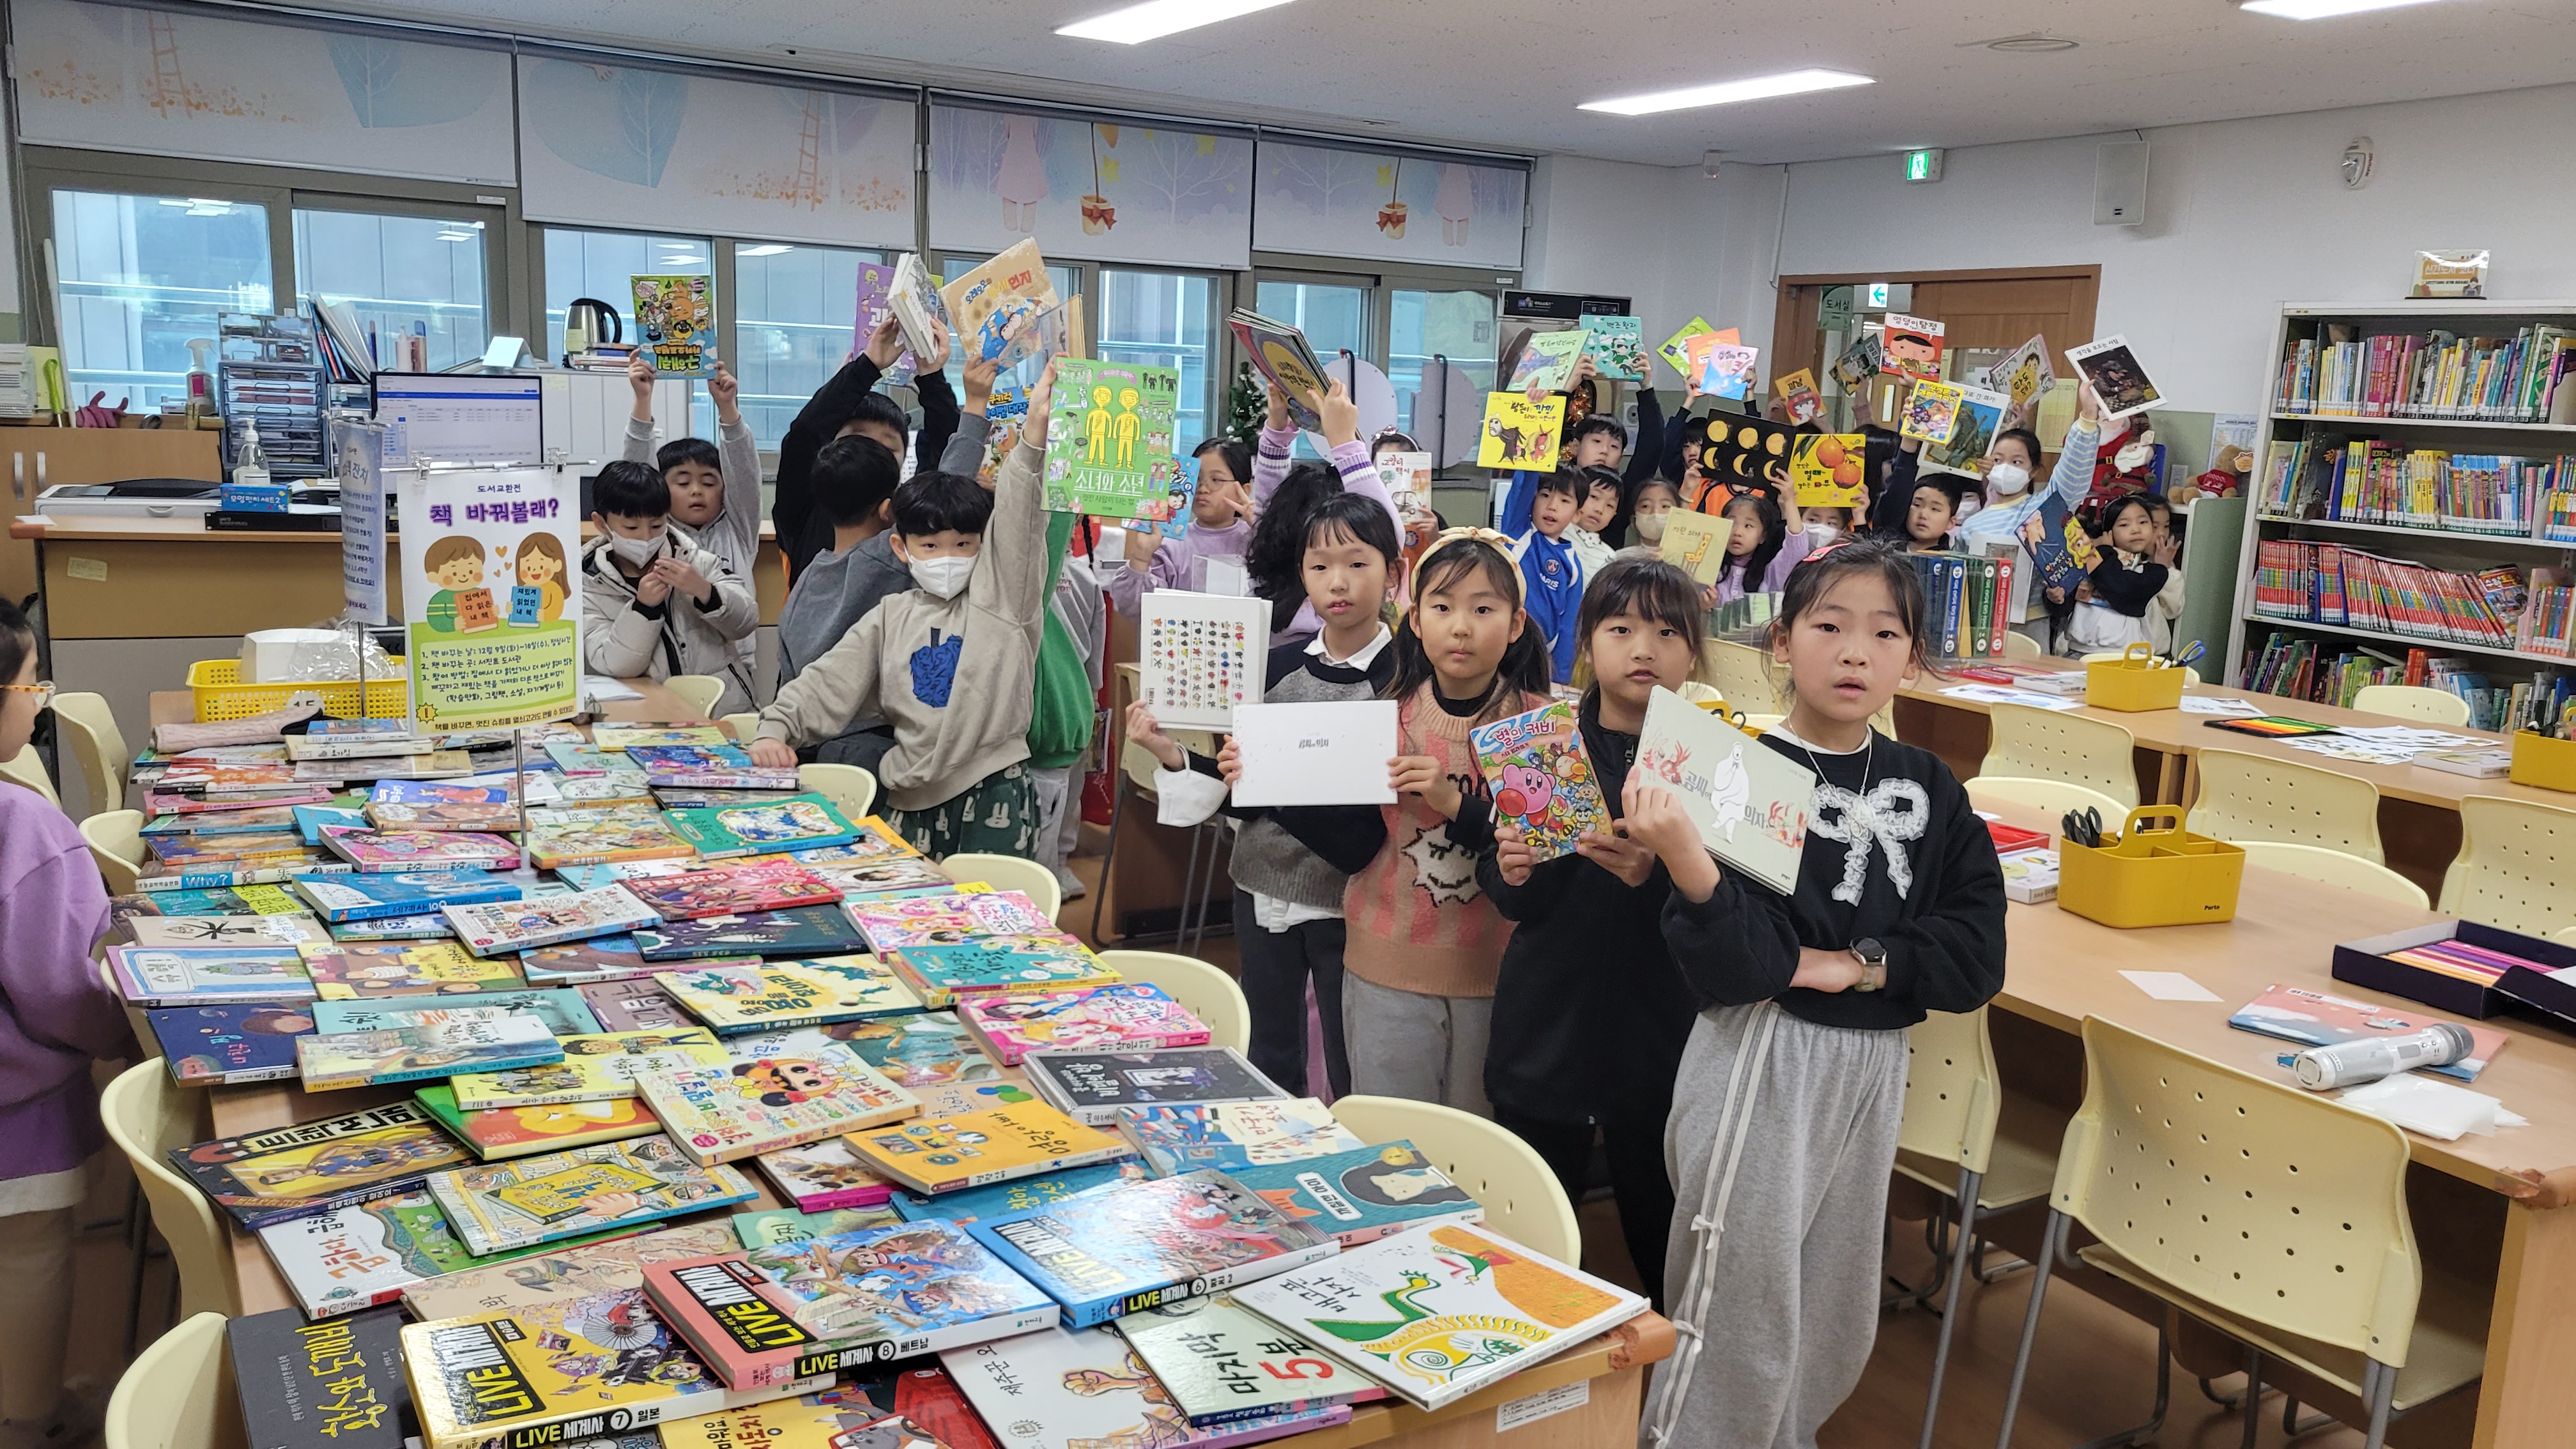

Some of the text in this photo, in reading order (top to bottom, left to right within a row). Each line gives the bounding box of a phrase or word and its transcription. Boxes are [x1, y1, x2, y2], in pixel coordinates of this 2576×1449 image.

[1826, 300, 1849, 310] 도서실
[1382, 454, 1403, 466] 고양이
[477, 484, 521, 493] 도서교환전
[1074, 470, 1114, 493] 소녀와
[1119, 473, 1144, 494] 소년
[430, 497, 559, 526] 책 바꿔볼래?
[464, 591, 487, 601] 집에서
[478, 601, 492, 610] 읽은
[431, 650, 440, 658] 책
[441, 648, 463, 657] 바꾸는
[466, 647, 476, 656] 날:
[479, 646, 493, 655] 12월
[441, 660, 464, 668] 바꾸는
[502, 655, 522, 664] 도서관
[433, 672, 448, 681] 참여
[471, 669, 493, 678] 집에서
[505, 666, 531, 675] 읽었거나
[540, 661, 551, 670] 이상
[462, 681, 482, 690] 재밌는
[533, 673, 549, 682] 책으로
[485, 689, 509, 700] 그림책,
[510, 688, 525, 697] 소설,
[556, 681, 564, 689] 등)
[435, 723, 448, 731] 책을
[451, 721, 474, 730] 바꾸면,
[513, 712, 542, 723] 열쇠고리도
[1495, 720, 1556, 747] 별의 커비
[1683, 774, 1767, 831] 곰씨의 의자
[185, 874, 228, 887] Why?
[1130, 1293, 1160, 1312] LIVE
[1160, 1285, 1188, 1303] 세계사
[800, 1353, 838, 1376] LIVE
[839, 1345, 874, 1368] 세계사
[900, 1337, 930, 1354] 베트남
[1177, 1332, 1261, 1394] 마지막
[467, 1367, 535, 1417] LIVE
[516, 1424, 562, 1448] LIVE
[562, 1415, 604, 1438] 세계사
[638, 1407, 661, 1423] 일본
